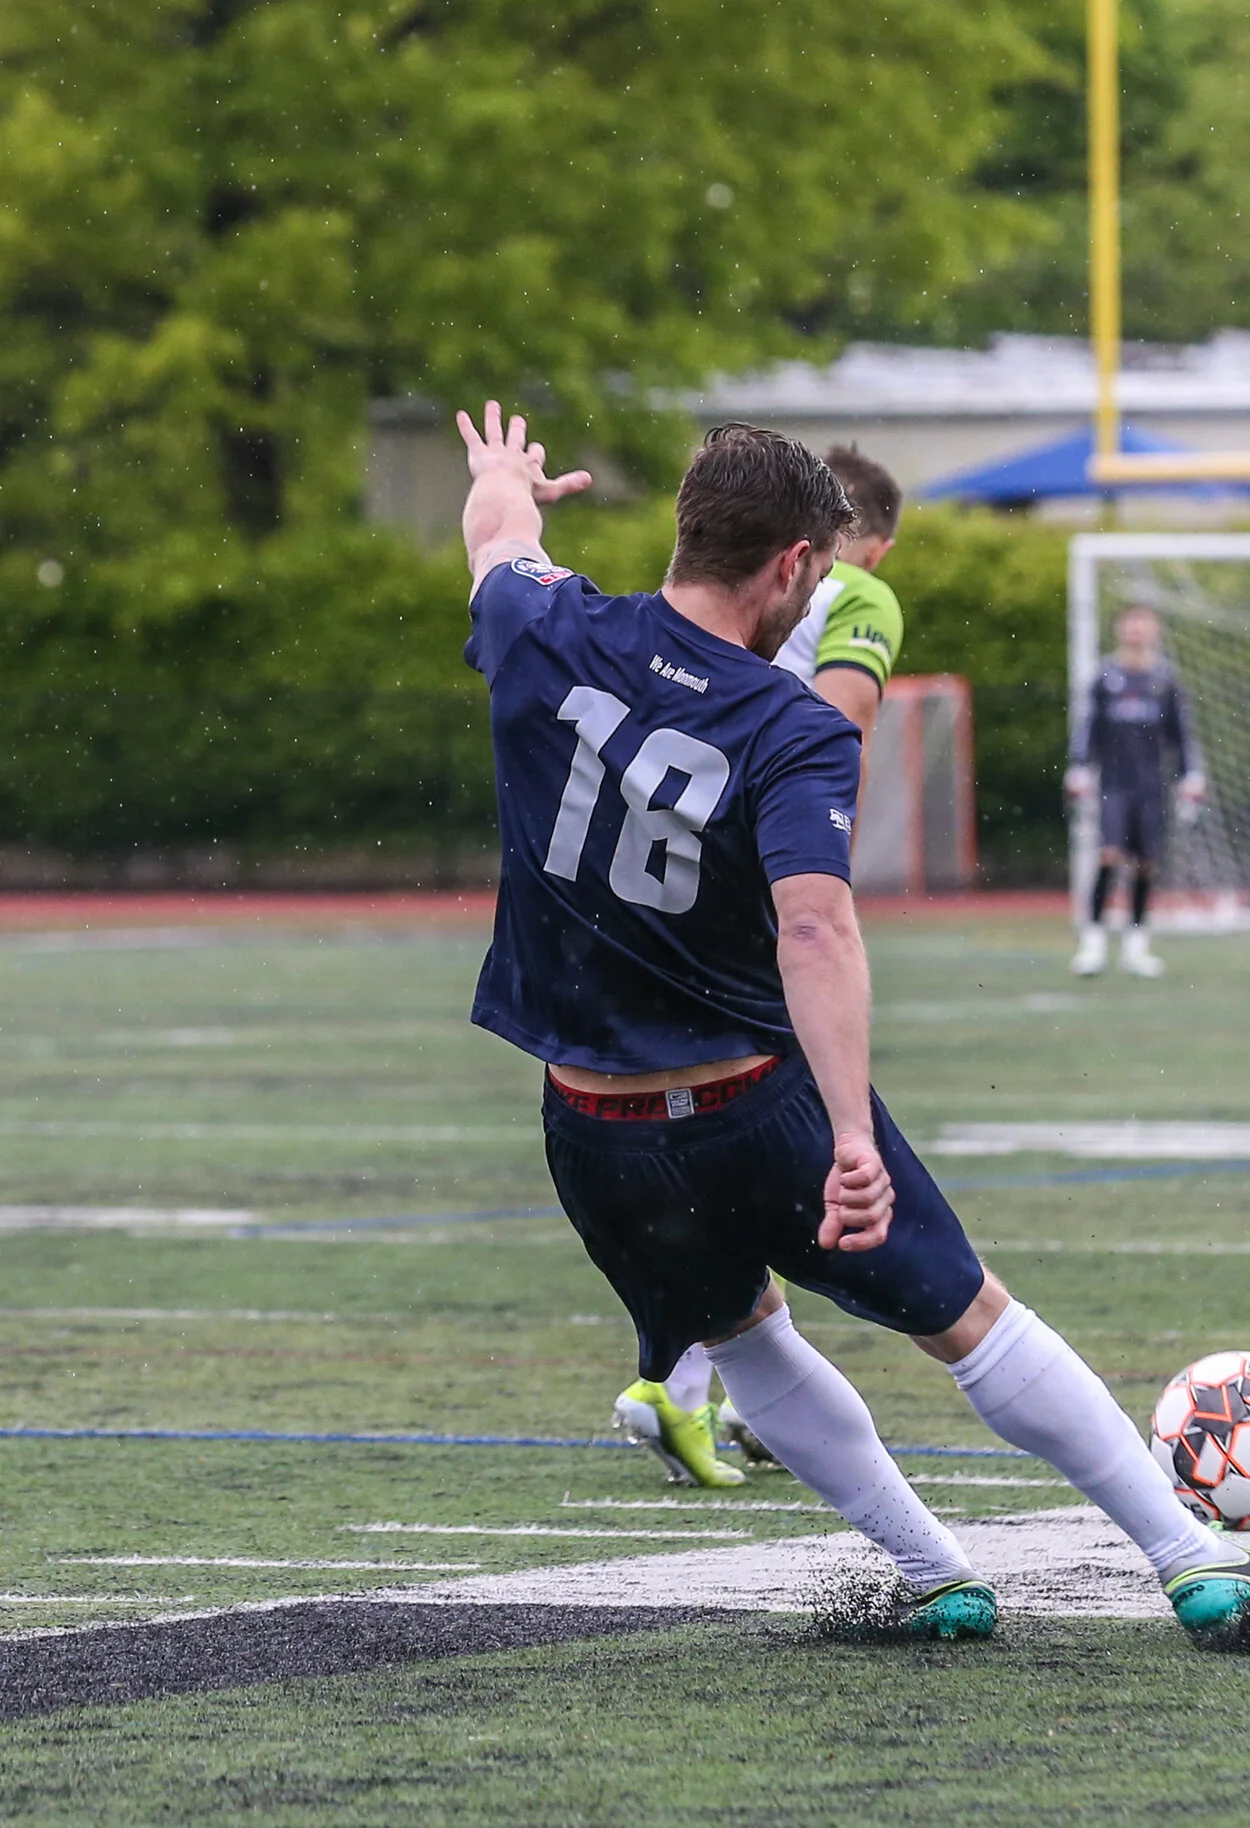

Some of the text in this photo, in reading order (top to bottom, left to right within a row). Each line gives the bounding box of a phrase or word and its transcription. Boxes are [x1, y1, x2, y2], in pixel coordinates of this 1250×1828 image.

[649, 654, 664, 673] We
[659, 662, 676, 679] Are
[543, 685, 730, 914] 18
